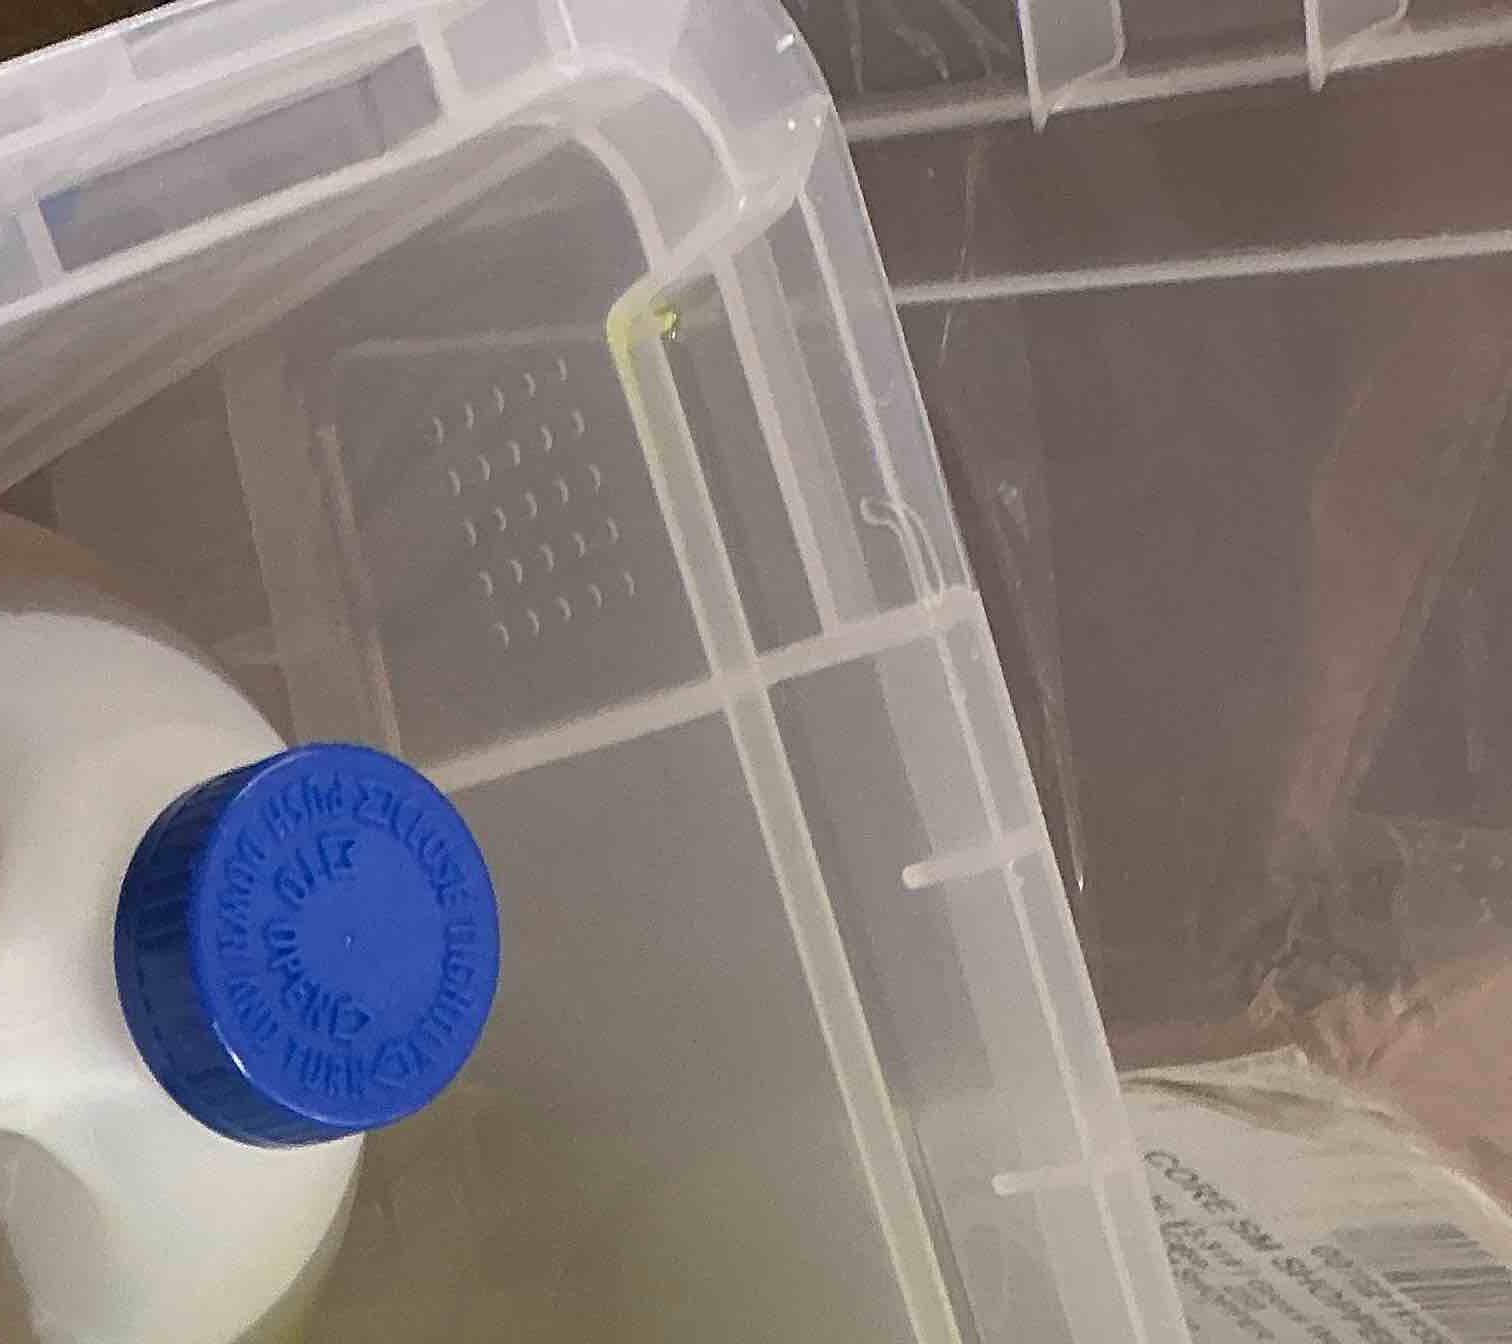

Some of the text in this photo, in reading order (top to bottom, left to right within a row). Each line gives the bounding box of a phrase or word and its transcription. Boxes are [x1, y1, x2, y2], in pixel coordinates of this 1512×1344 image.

[261, 771, 345, 845] PUSH
[216, 826, 268, 959] DOWN
[261, 845, 336, 1040] TO OPEN
[389, 795, 477, 1066] CLOSE TIGHTLY
[280, 1036, 366, 1098] TURN
